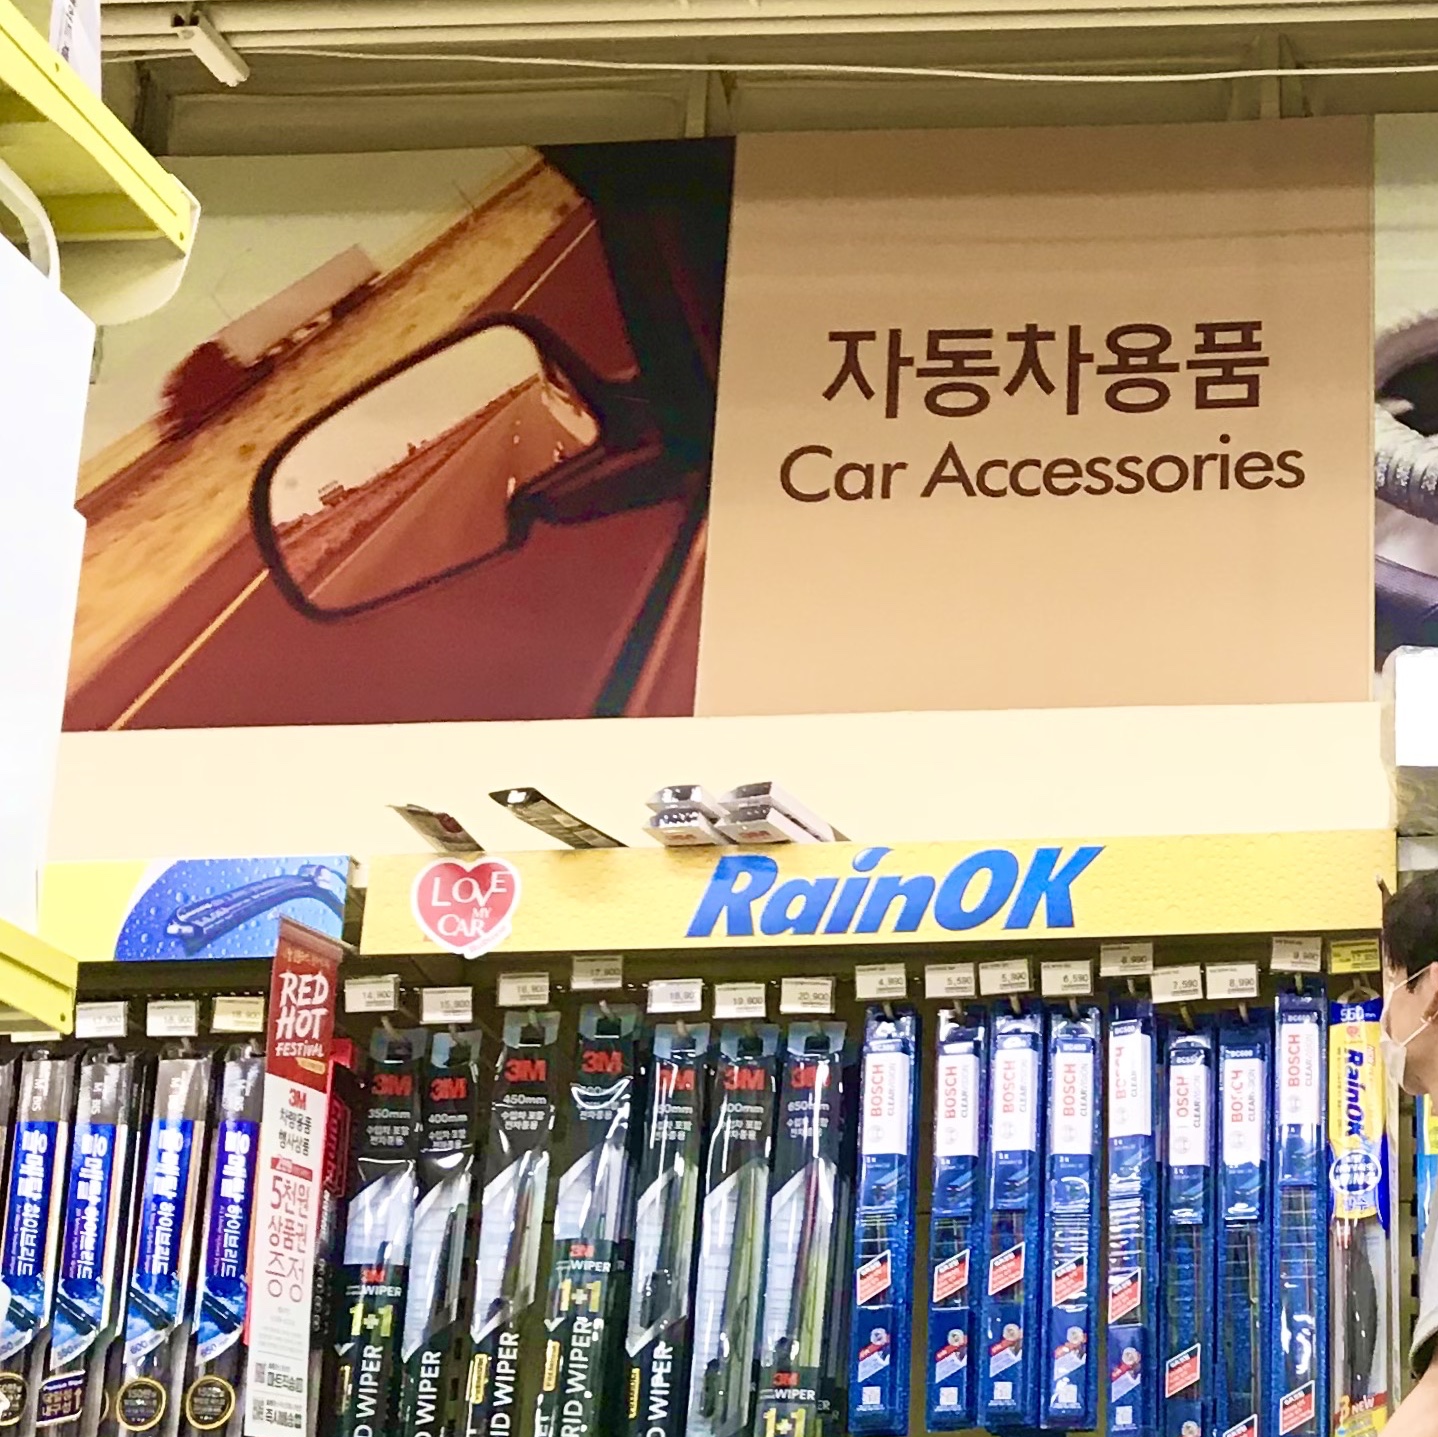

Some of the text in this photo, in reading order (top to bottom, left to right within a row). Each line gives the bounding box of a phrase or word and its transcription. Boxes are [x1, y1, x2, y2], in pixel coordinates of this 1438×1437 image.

[822, 320, 1271, 419] 자동차용품
[780, 433, 1307, 503] Car Accessories
[431, 870, 513, 907] LOVE
[685, 845, 1106, 939] RainOK
[437, 913, 486, 938] CAR
[472, 906, 491, 919] MY
[278, 970, 329, 1009] RED
[275, 1006, 329, 1041] HOT
[505, 1058, 546, 1083] 3M
[582, 1050, 623, 1074] 3M
[1288, 1034, 1300, 1088] BOSCH
[289, 1088, 307, 1110] 3M
[372, 1074, 413, 1096] 3M
[430, 1078, 467, 1101] 3M
[503, 1094, 547, 1106] 450mm
[870, 1064, 885, 1118] BOSCH
[944, 1066, 958, 1120] BOSCH
[1002, 1060, 1016, 1114] BOSCH
[1063, 1063, 1077, 1117] BOSCH
[1346, 1048, 1366, 1139] RainOK
[367, 1108, 411, 1120] 350mm
[428, 1113, 468, 1124] 400mm
[270, 1175, 310, 1220] 5천원
[16, 1202, 41, 1277] 하이브리드
[220, 1205, 243, 1278] 하이브리드
[268, 1214, 309, 1254] 상품권
[265, 1252, 305, 1303] 증정
[569, 1259, 611, 1273] WIPER
[361, 1284, 402, 1297] WIPER
[559, 1278, 601, 1313] 1+1
[349, 1301, 394, 1338] 1+1
[492, 1331, 520, 1408] WIPER
[566, 1316, 592, 1396] WIPER
[356, 1344, 384, 1419] WIPER
[415, 1349, 442, 1427] WIPER
[647, 1340, 674, 1424] WIPER
[774, 1388, 816, 1401] WIPER
[1338, 1394, 1375, 1417] 3 NEW
